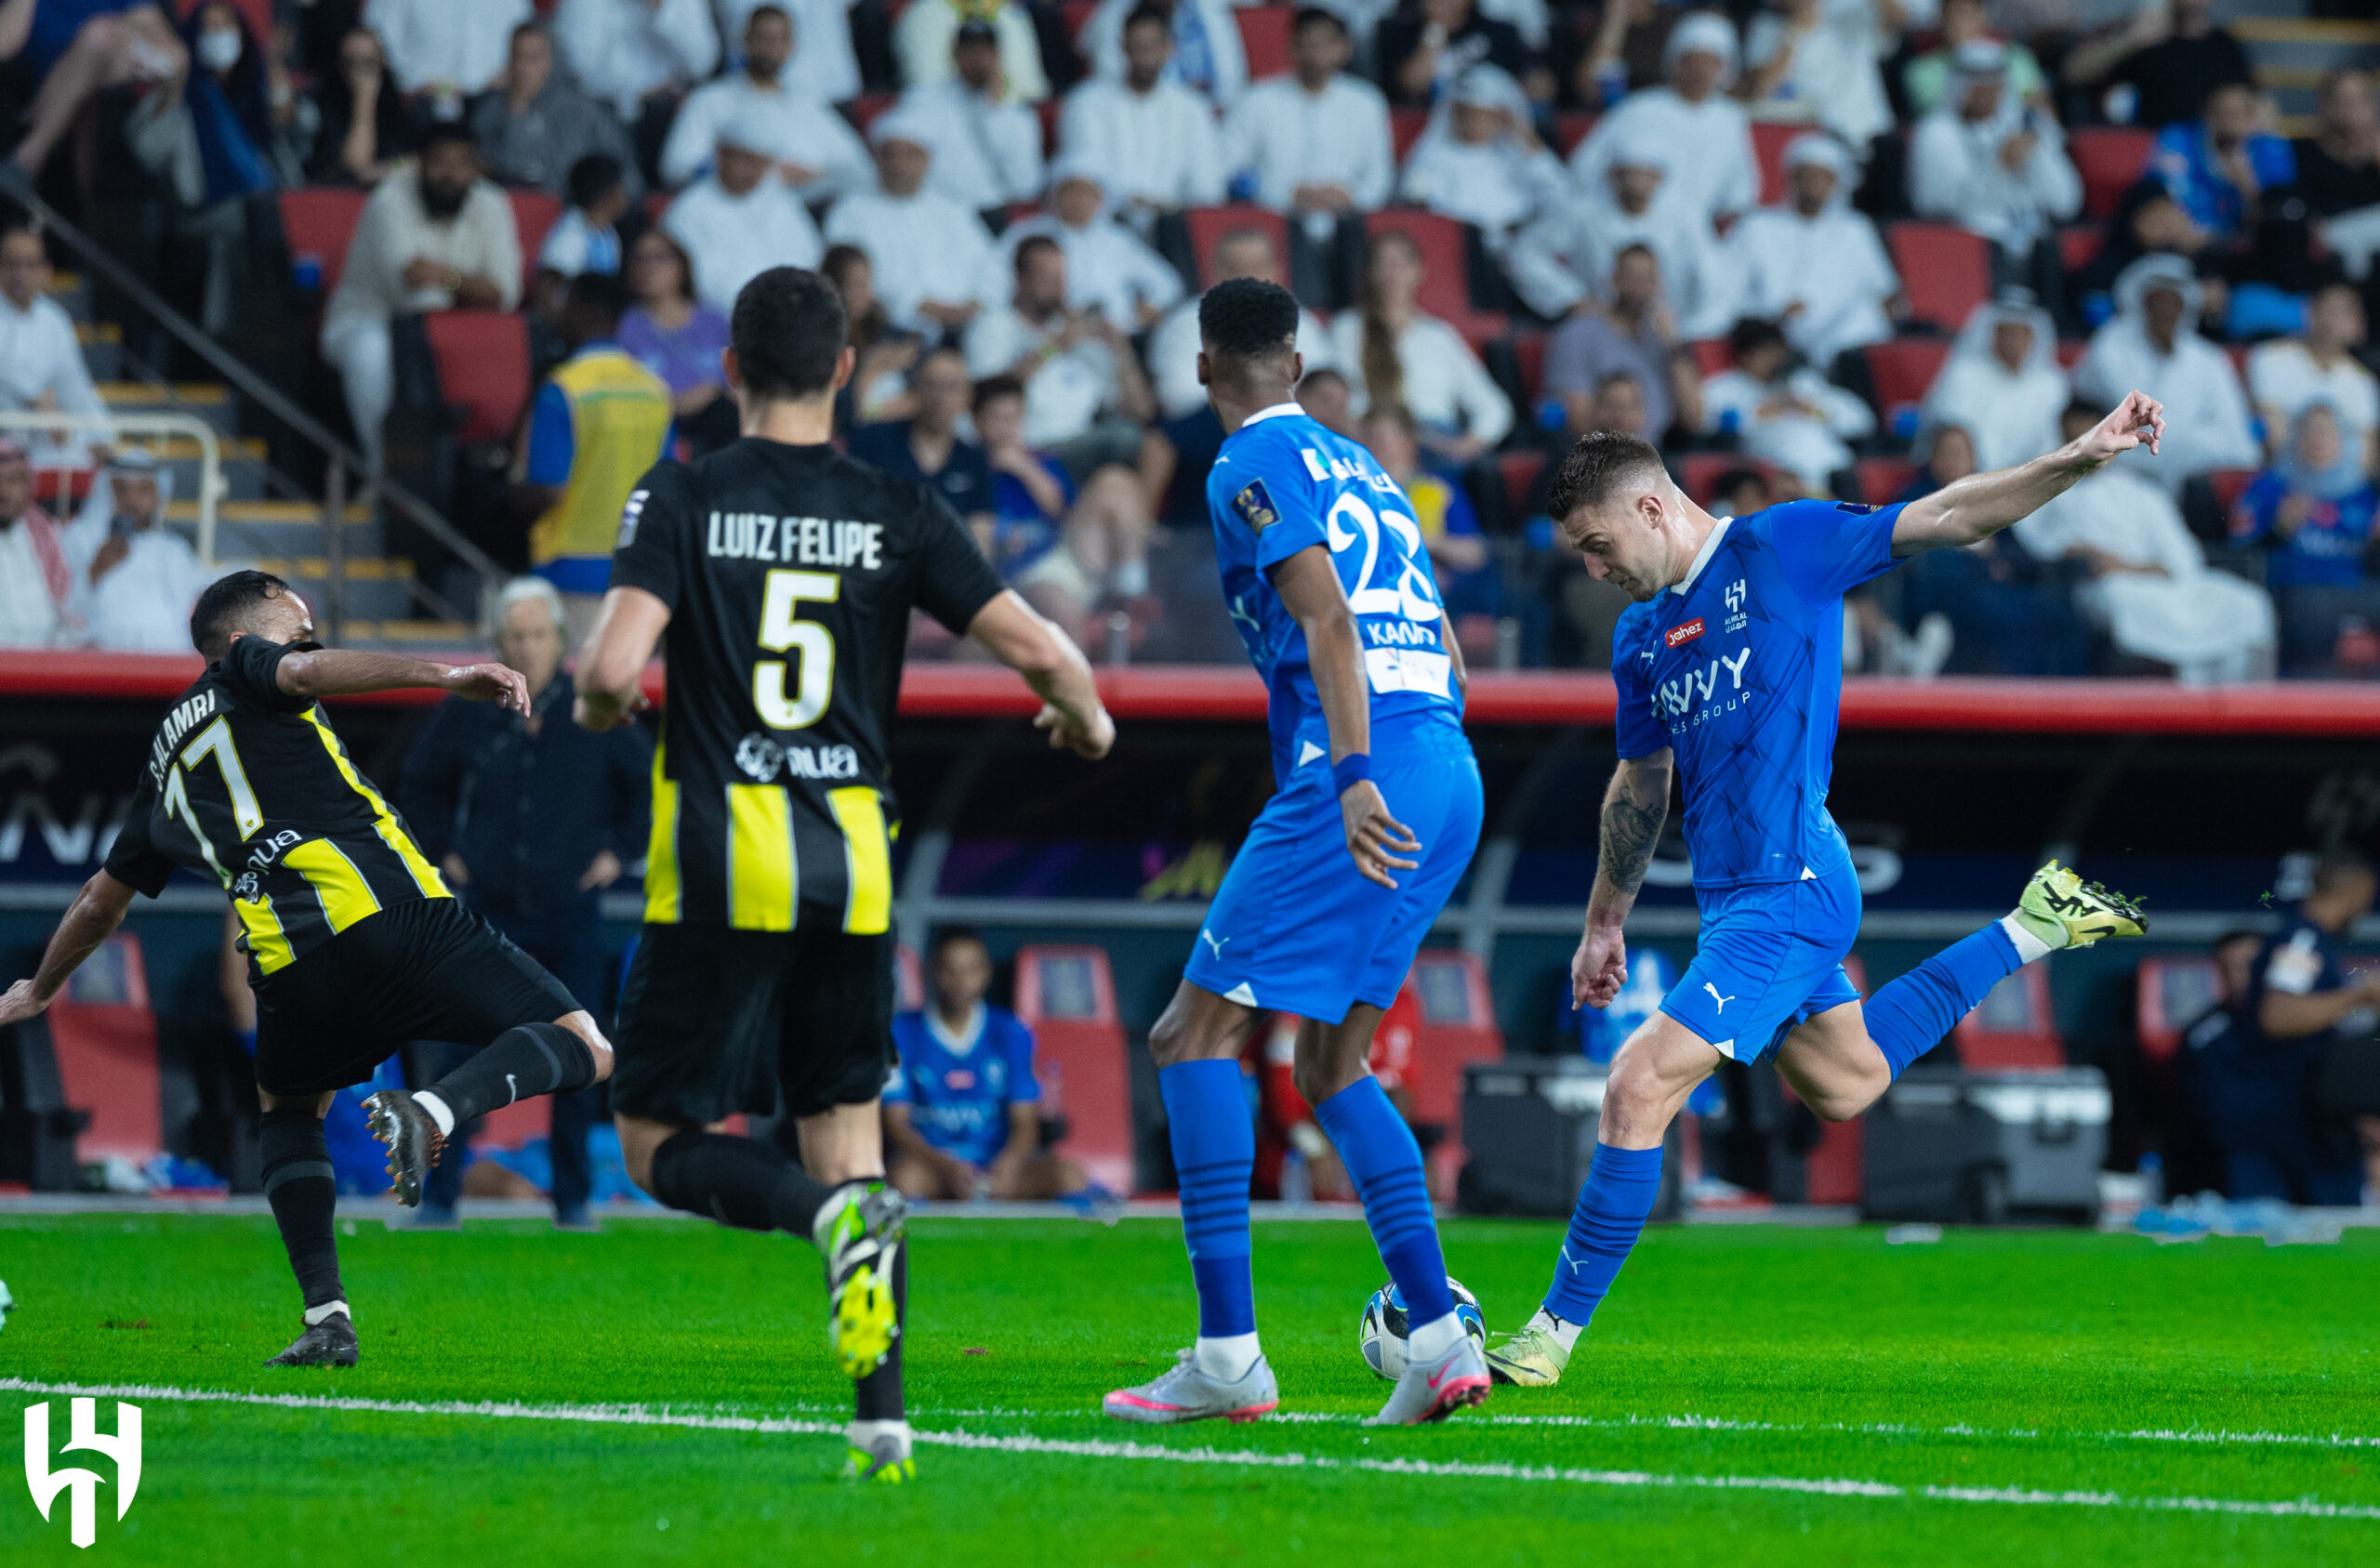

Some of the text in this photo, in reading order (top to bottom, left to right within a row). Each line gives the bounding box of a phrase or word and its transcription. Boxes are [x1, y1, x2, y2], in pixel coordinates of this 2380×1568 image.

[707, 510, 883, 570] LUIZ FELIPE
[752, 569, 840, 730] 5
[1669, 622, 1702, 646] jahez
[1693, 692, 1751, 726] GROUP
[164, 714, 265, 890] 17
